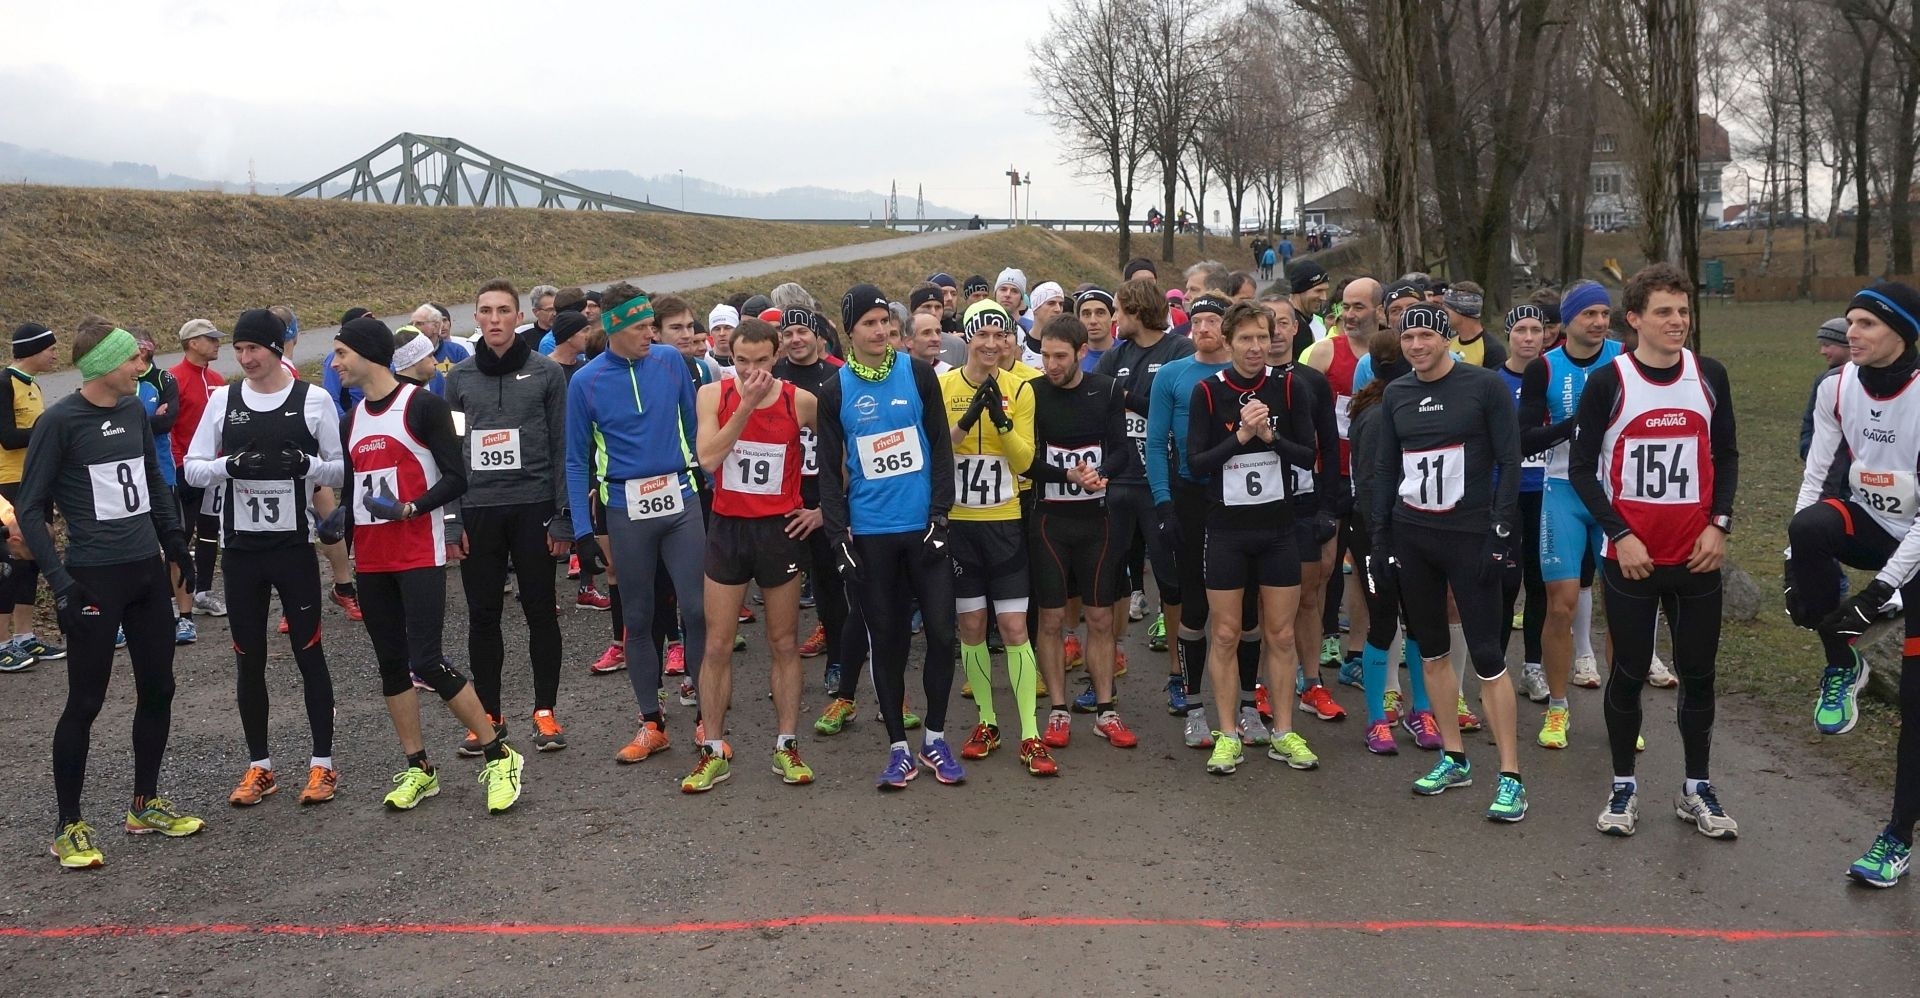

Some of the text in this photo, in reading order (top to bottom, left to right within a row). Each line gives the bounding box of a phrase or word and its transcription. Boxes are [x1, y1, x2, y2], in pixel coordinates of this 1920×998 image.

[1418, 404, 1444, 413] skinfit
[1645, 417, 1687, 428] GRAVAG
[876, 435, 901, 450] rivella
[480, 450, 515, 466] 395
[872, 451, 913, 473] 365
[737, 458, 770, 485] 19
[957, 458, 1002, 505] 141
[1416, 454, 1445, 505] 11
[1630, 444, 1690, 499] 154
[1862, 474, 1890, 484] rivella
[116, 462, 140, 513] 8
[643, 479, 665, 492] rivella
[1245, 471, 1263, 497] 6
[246, 497, 280, 524] 13
[638, 495, 675, 514] 368
[1859, 488, 1903, 514] 382
